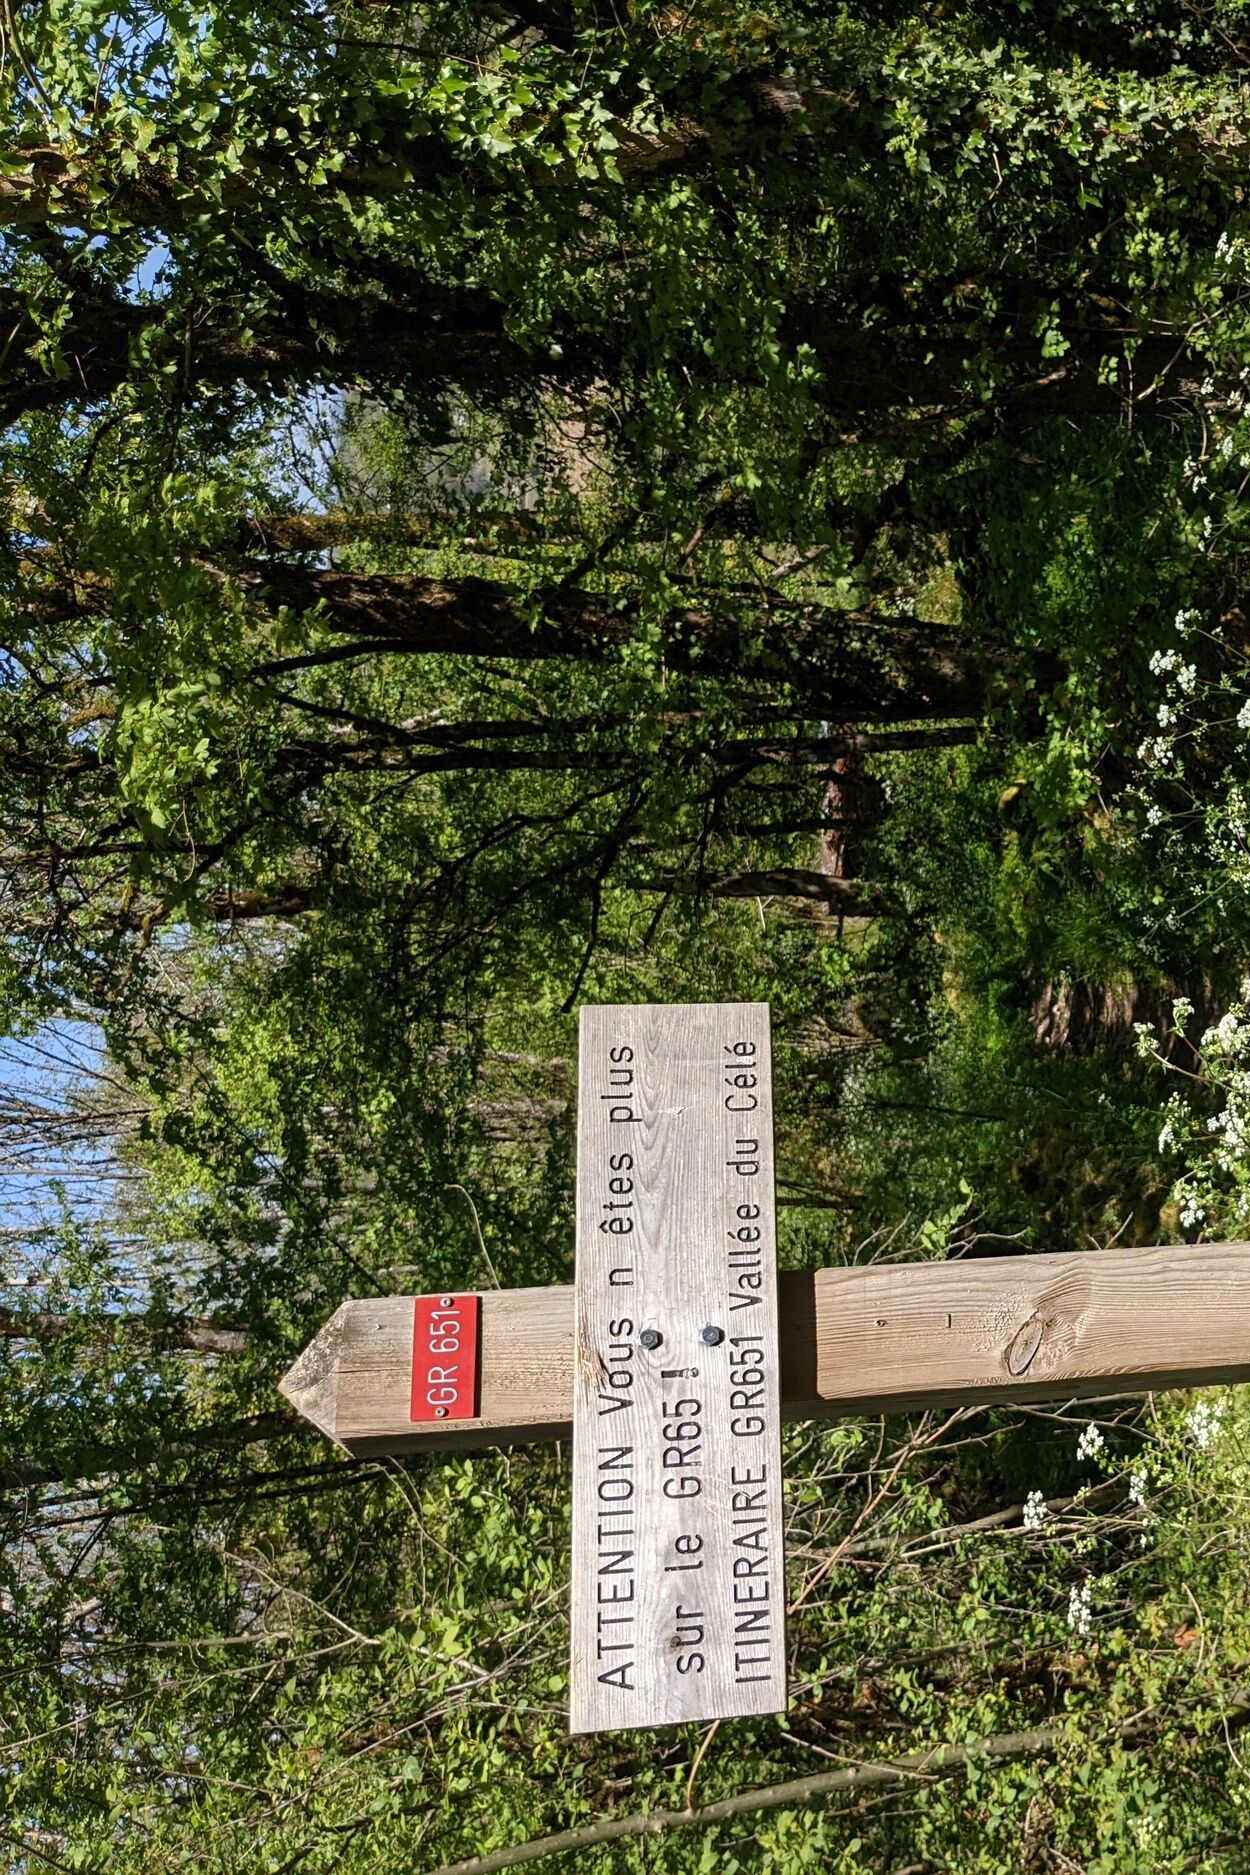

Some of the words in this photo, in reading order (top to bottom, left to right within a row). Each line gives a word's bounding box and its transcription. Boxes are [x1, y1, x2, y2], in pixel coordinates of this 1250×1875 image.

[600, 1045, 643, 1123] plus
[724, 1040, 759, 1112] Célé
[599, 1152, 634, 1235] êtes
[726, 1138, 760, 1177] du
[608, 1267, 635, 1286] n
[727, 1203, 764, 1311] Vallée
[429, 1310, 461, 1353] 651
[598, 1317, 635, 1416] Vous
[427, 1365, 459, 1405] GR
[729, 1335, 766, 1437] GR651
[597, 1446, 635, 1690] ATTENTION
[664, 1533, 705, 1572] le
[731, 1463, 772, 1684] ITINERAIRE
[675, 1604, 705, 1675] sur
